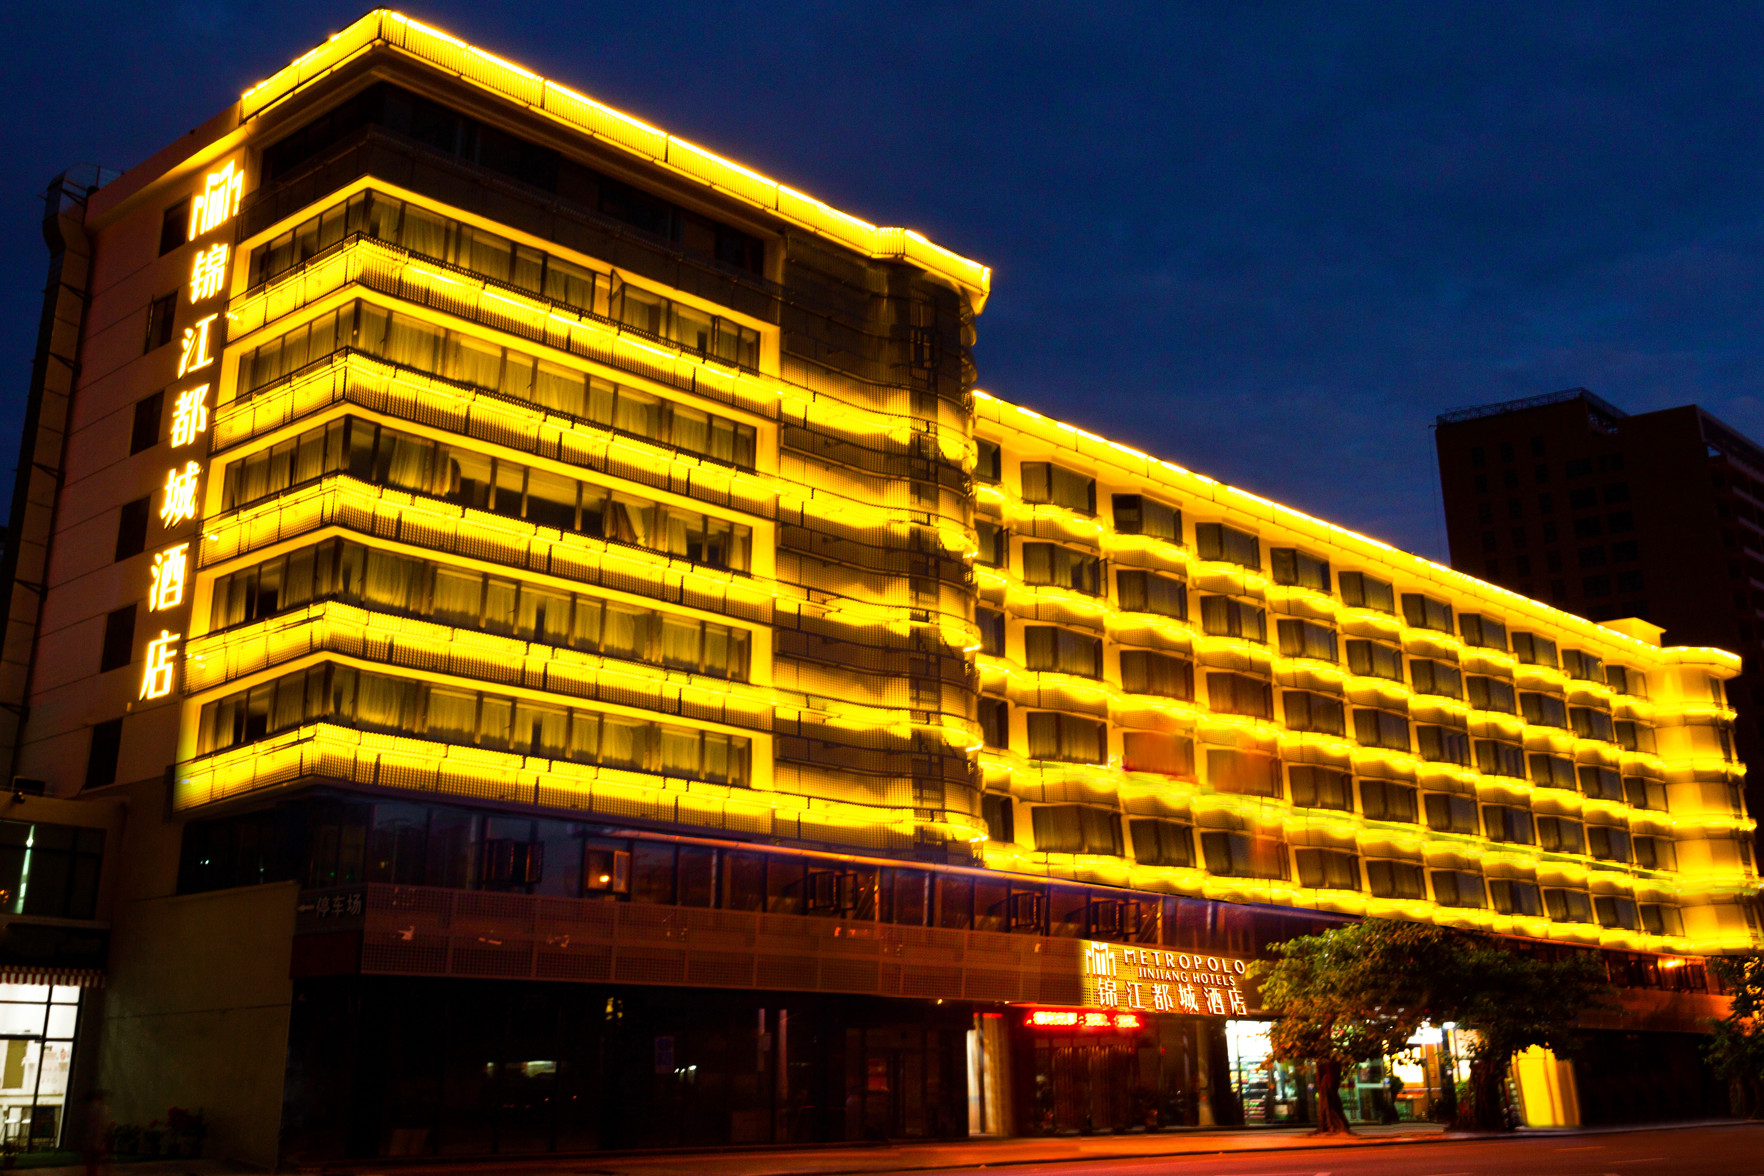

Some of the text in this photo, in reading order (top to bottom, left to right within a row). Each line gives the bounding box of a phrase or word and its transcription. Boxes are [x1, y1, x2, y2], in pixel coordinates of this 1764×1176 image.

[139, 241, 229, 701] 锦江都城酒店
[316, 893, 362, 918] 停车场
[1123, 948, 1245, 974] METROPOLO
[1138, 967, 1236, 987] JINJIANG HOTELS
[1097, 977, 1247, 1015] 锦江都城酒店
